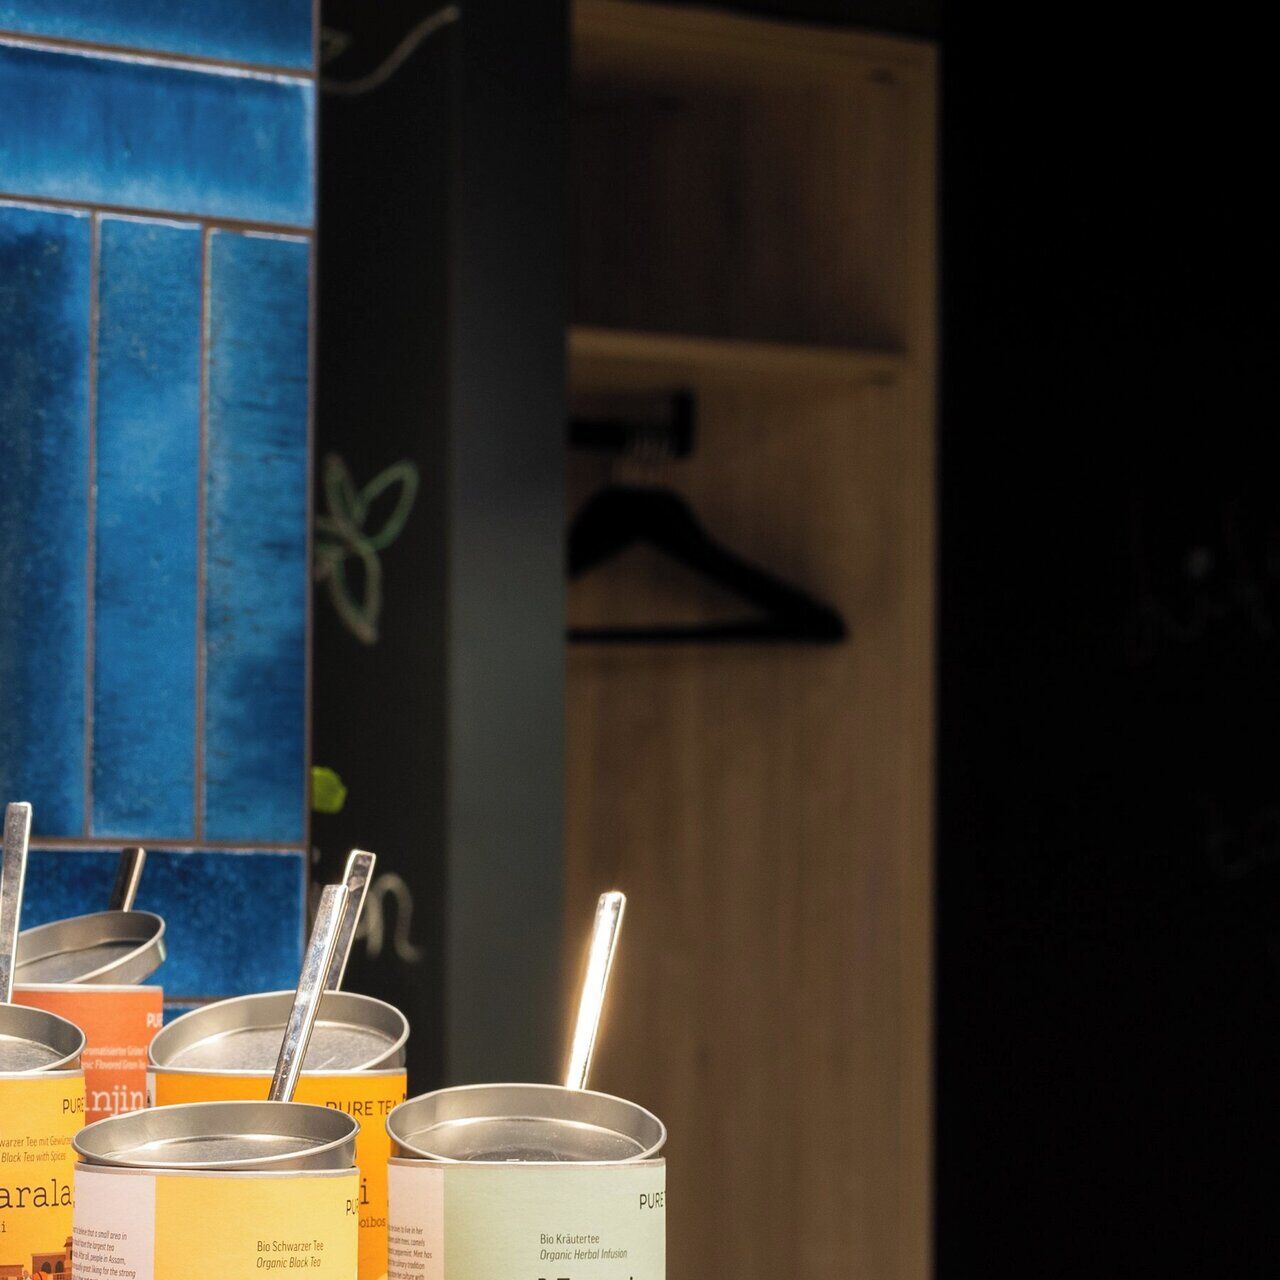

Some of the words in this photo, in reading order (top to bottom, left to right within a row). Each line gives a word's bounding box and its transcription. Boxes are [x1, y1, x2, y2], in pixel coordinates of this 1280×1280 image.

[25, 1136, 38, 1147] Tee
[38, 1136, 50, 1146] mit
[1, 1152, 22, 1163] Black
[23, 1152, 35, 1162] Tea
[540, 1233, 554, 1245] Bio
[556, 1233, 600, 1244] Kräutertee
[257, 1240, 270, 1252] Bio
[272, 1240, 312, 1252] Schwarzer
[313, 1239, 324, 1251] Tee
[540, 1249, 572, 1262] Organic
[574, 1249, 600, 1260] Herbal
[601, 1248, 628, 1259] Infusion
[256, 1256, 287, 1270] Organic
[289, 1256, 309, 1268] Black
[310, 1256, 322, 1268] Tea
[118, 1269, 137, 1279] strong
